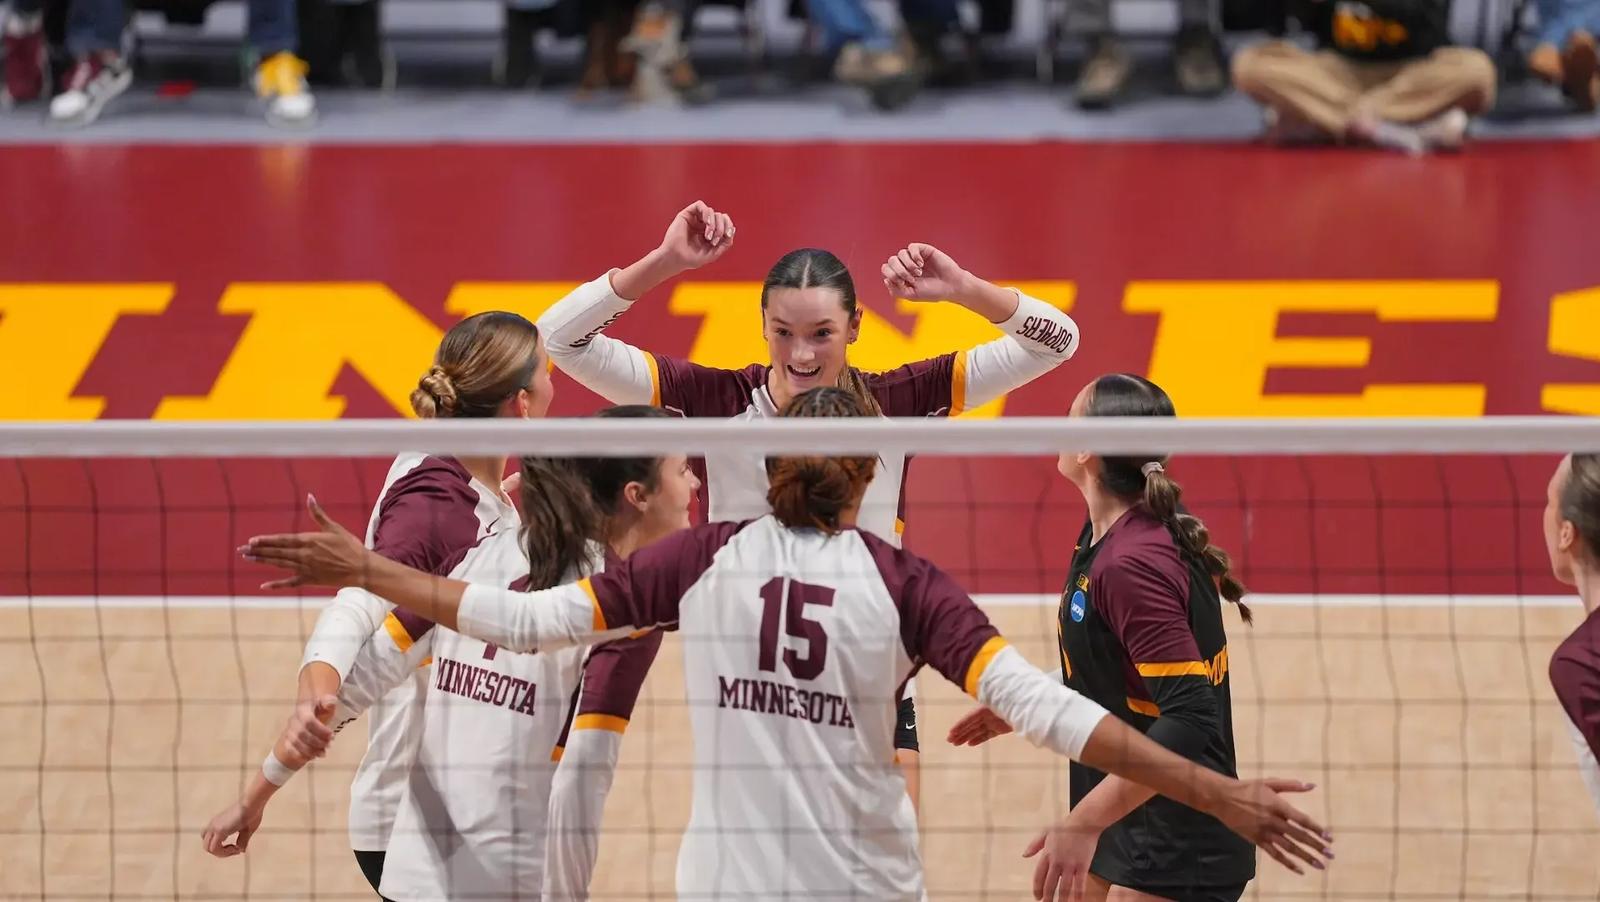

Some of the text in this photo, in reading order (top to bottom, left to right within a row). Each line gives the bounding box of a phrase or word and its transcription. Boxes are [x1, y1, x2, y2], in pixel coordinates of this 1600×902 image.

[0, 279, 1600, 419] INNE
[1016, 316, 1072, 353] GOPHERS
[758, 576, 836, 681] 15
[718, 676, 855, 728] MINNESOTA
